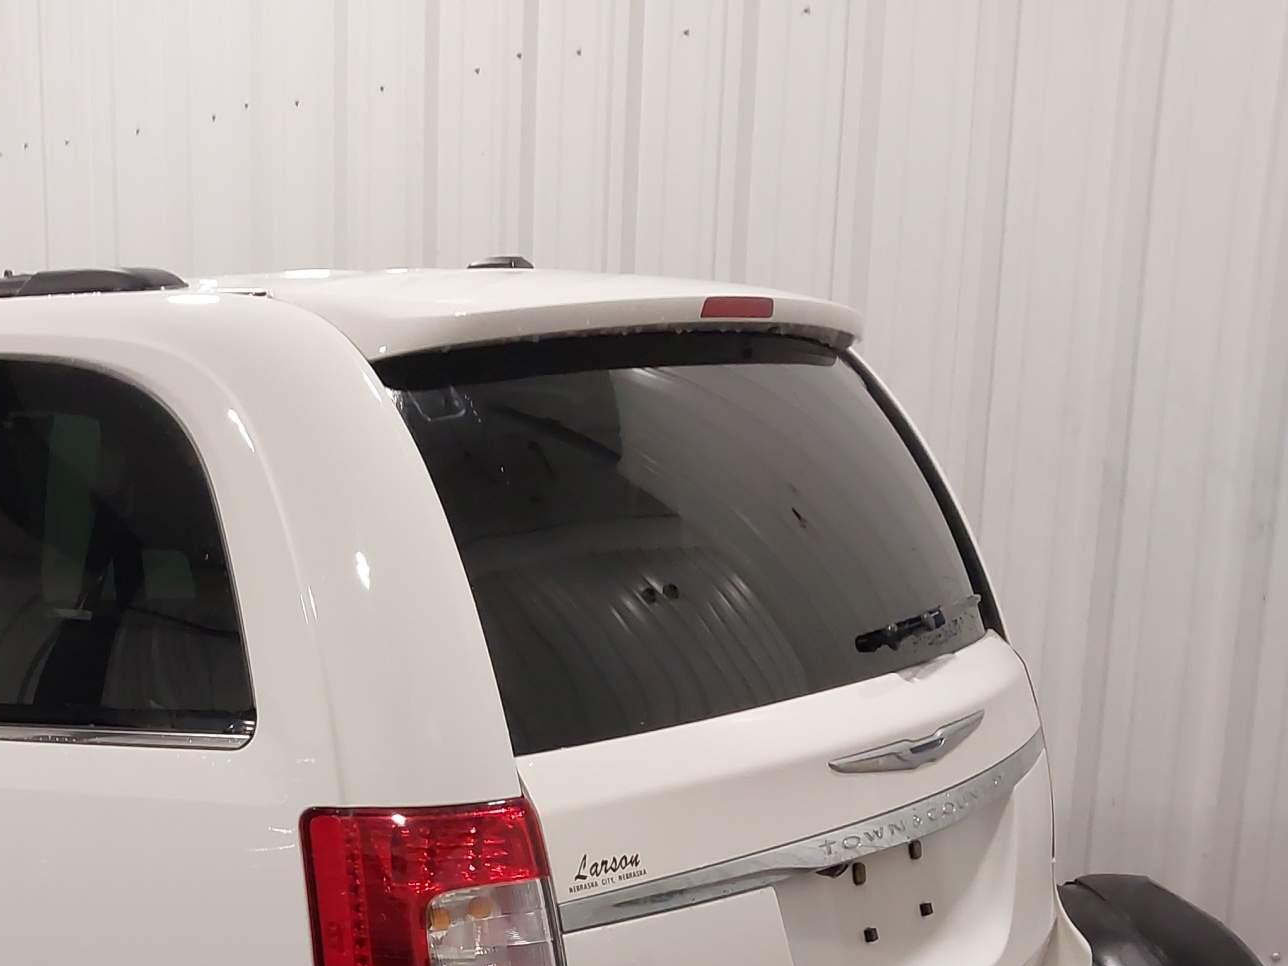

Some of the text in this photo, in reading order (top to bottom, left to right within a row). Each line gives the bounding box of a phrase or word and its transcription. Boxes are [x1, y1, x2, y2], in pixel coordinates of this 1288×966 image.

[818, 820, 906, 855] TOWN
[574, 853, 641, 880] Larson
[569, 880, 598, 893] NEBRASKA
[618, 869, 648, 881] NEBRASKA
